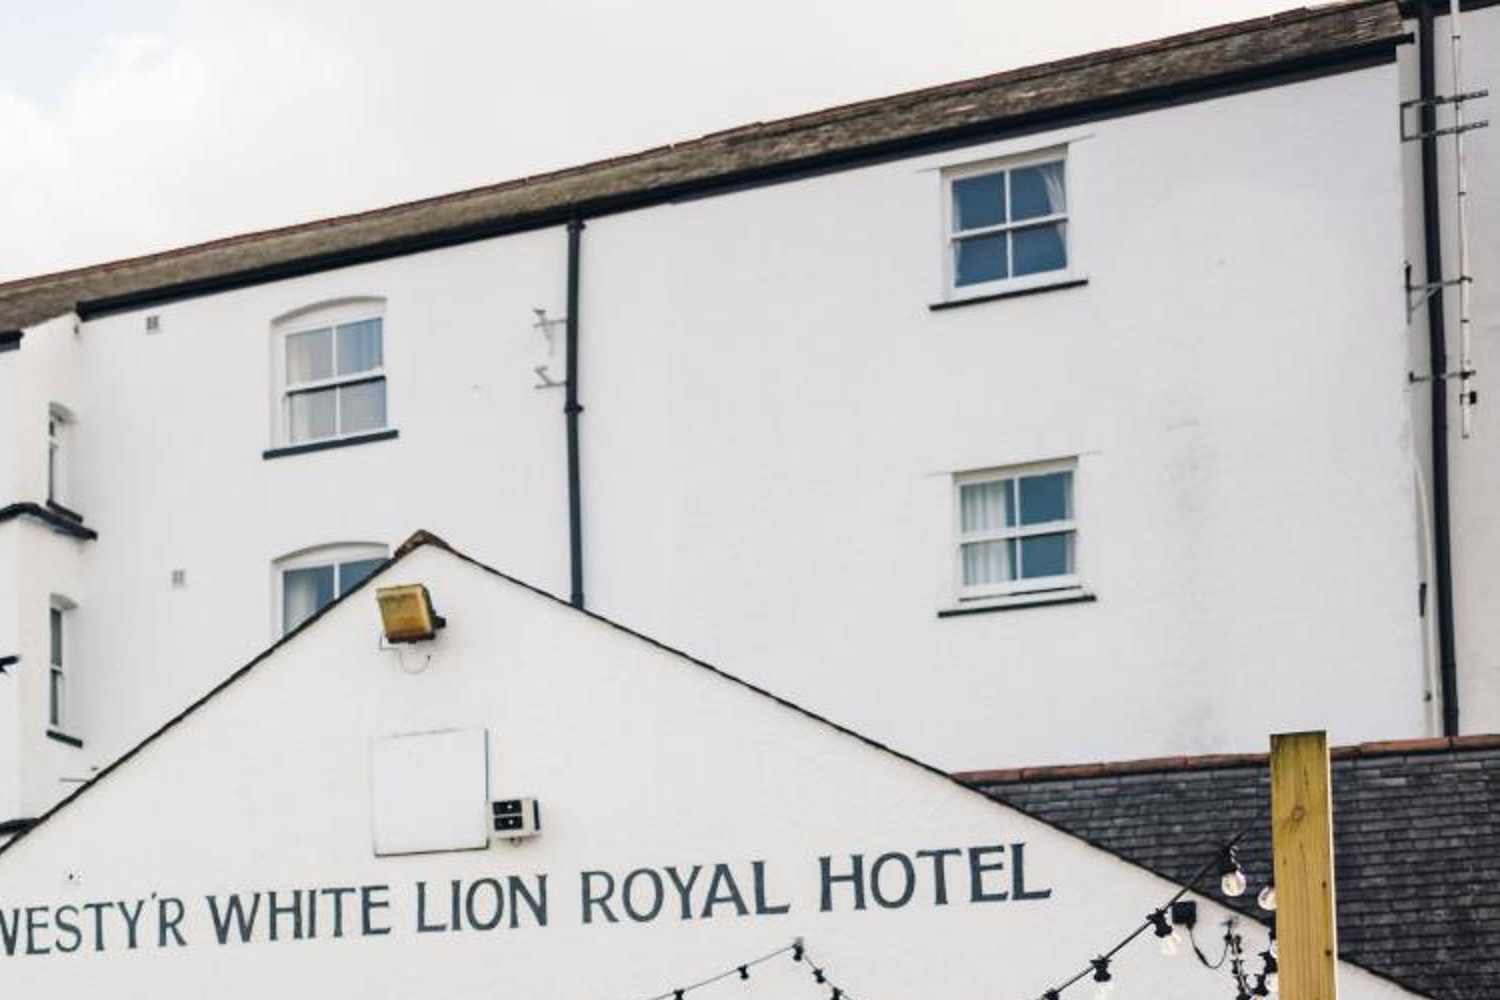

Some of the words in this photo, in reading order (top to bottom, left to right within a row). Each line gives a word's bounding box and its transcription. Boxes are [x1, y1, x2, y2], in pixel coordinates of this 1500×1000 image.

[205, 884, 392, 945] WHITE
[415, 873, 549, 933] LION
[580, 860, 791, 924] ROYAL
[818, 842, 1053, 912] HOTEL
